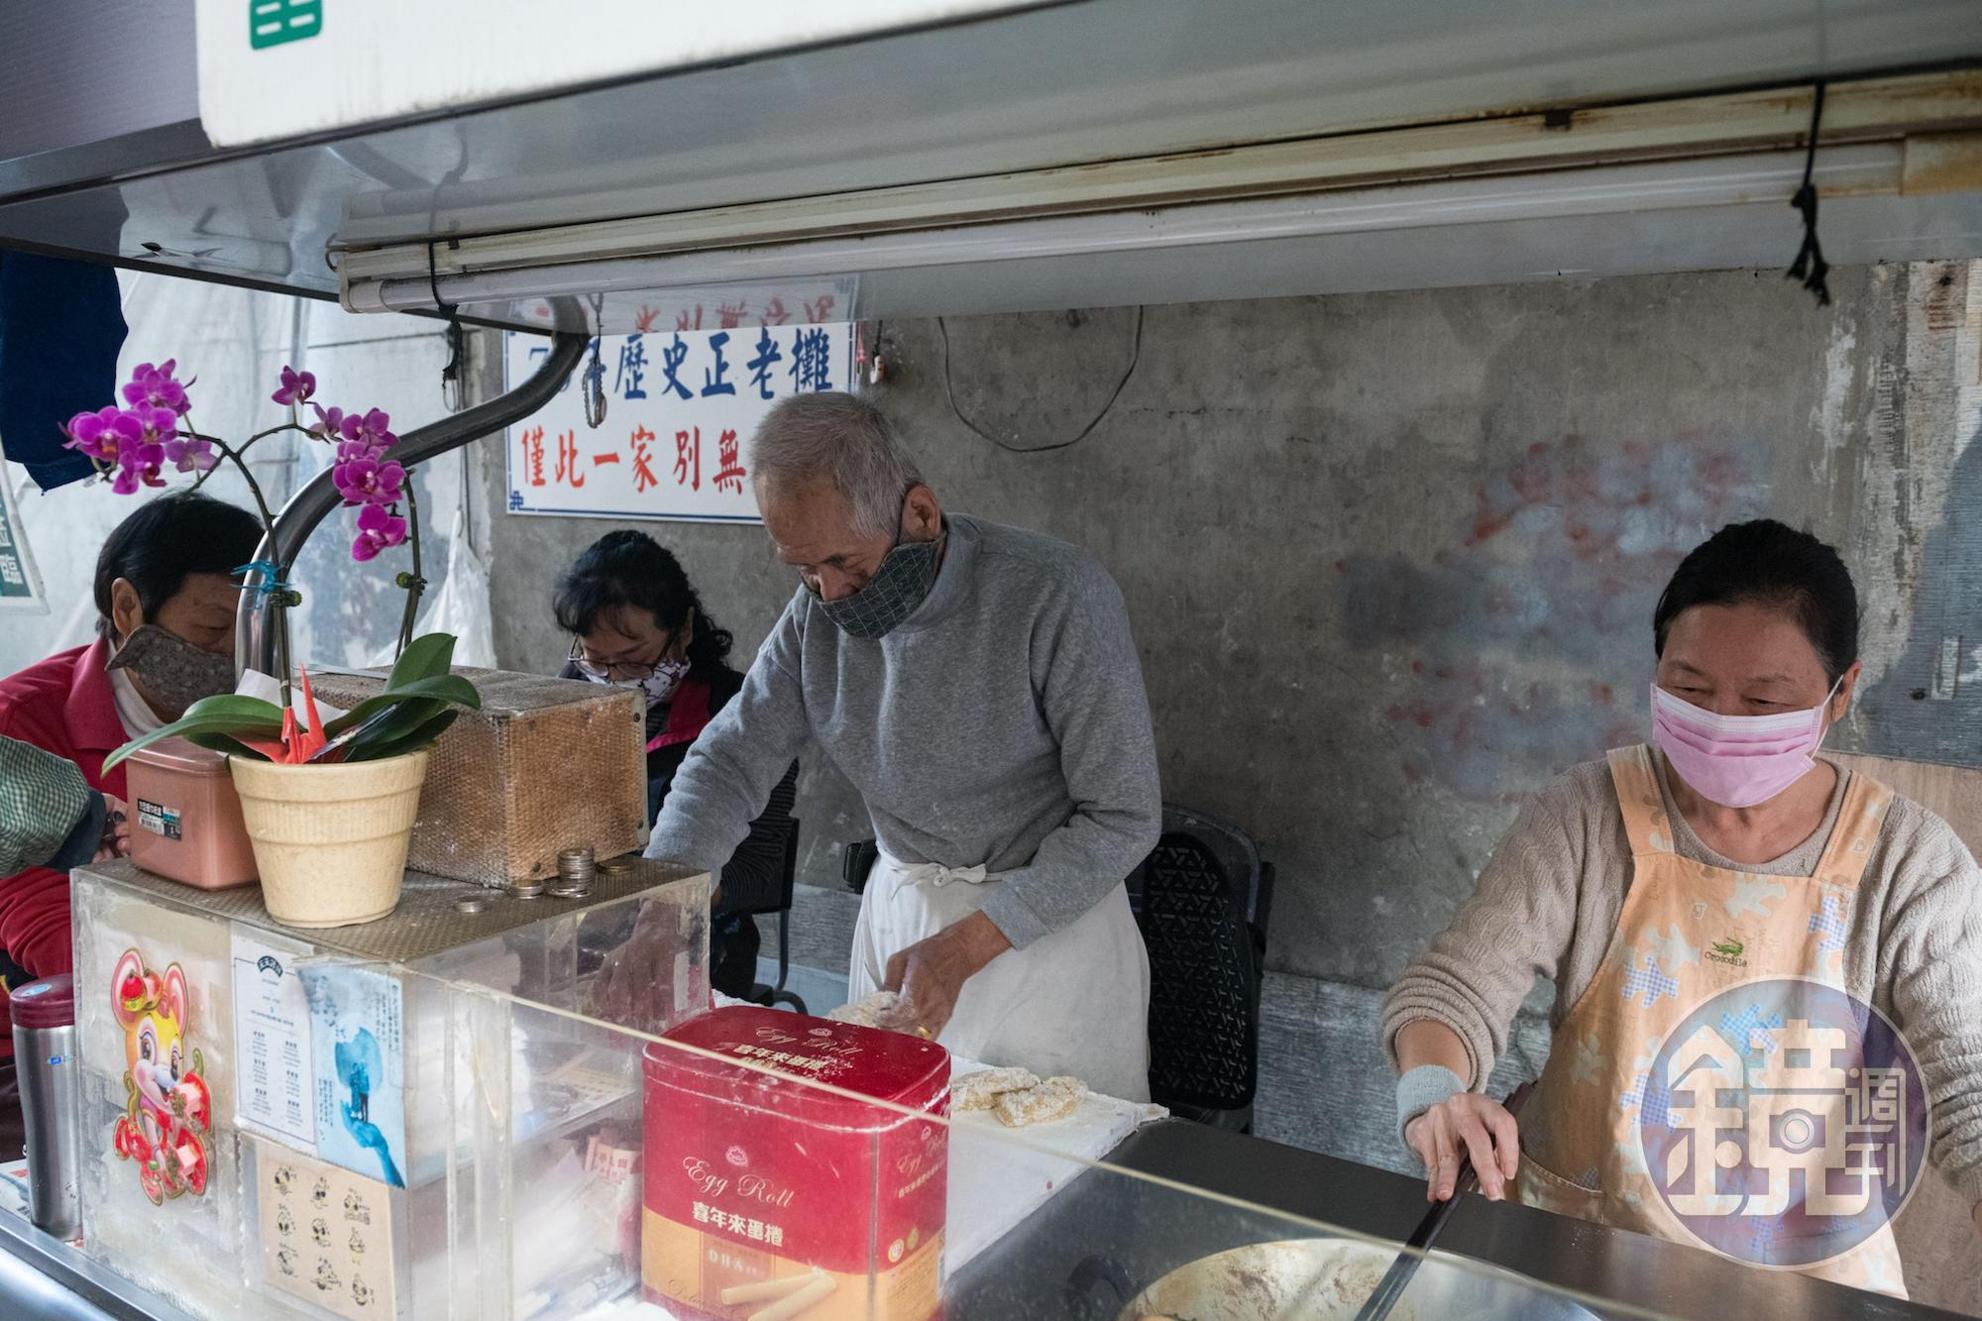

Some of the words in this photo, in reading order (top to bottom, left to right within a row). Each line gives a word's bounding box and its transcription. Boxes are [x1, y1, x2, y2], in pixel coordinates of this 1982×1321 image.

[521, 425, 747, 495] 僅此一家別無
[682, 1156, 728, 1197] Egg
[737, 1174, 794, 1208] Roll
